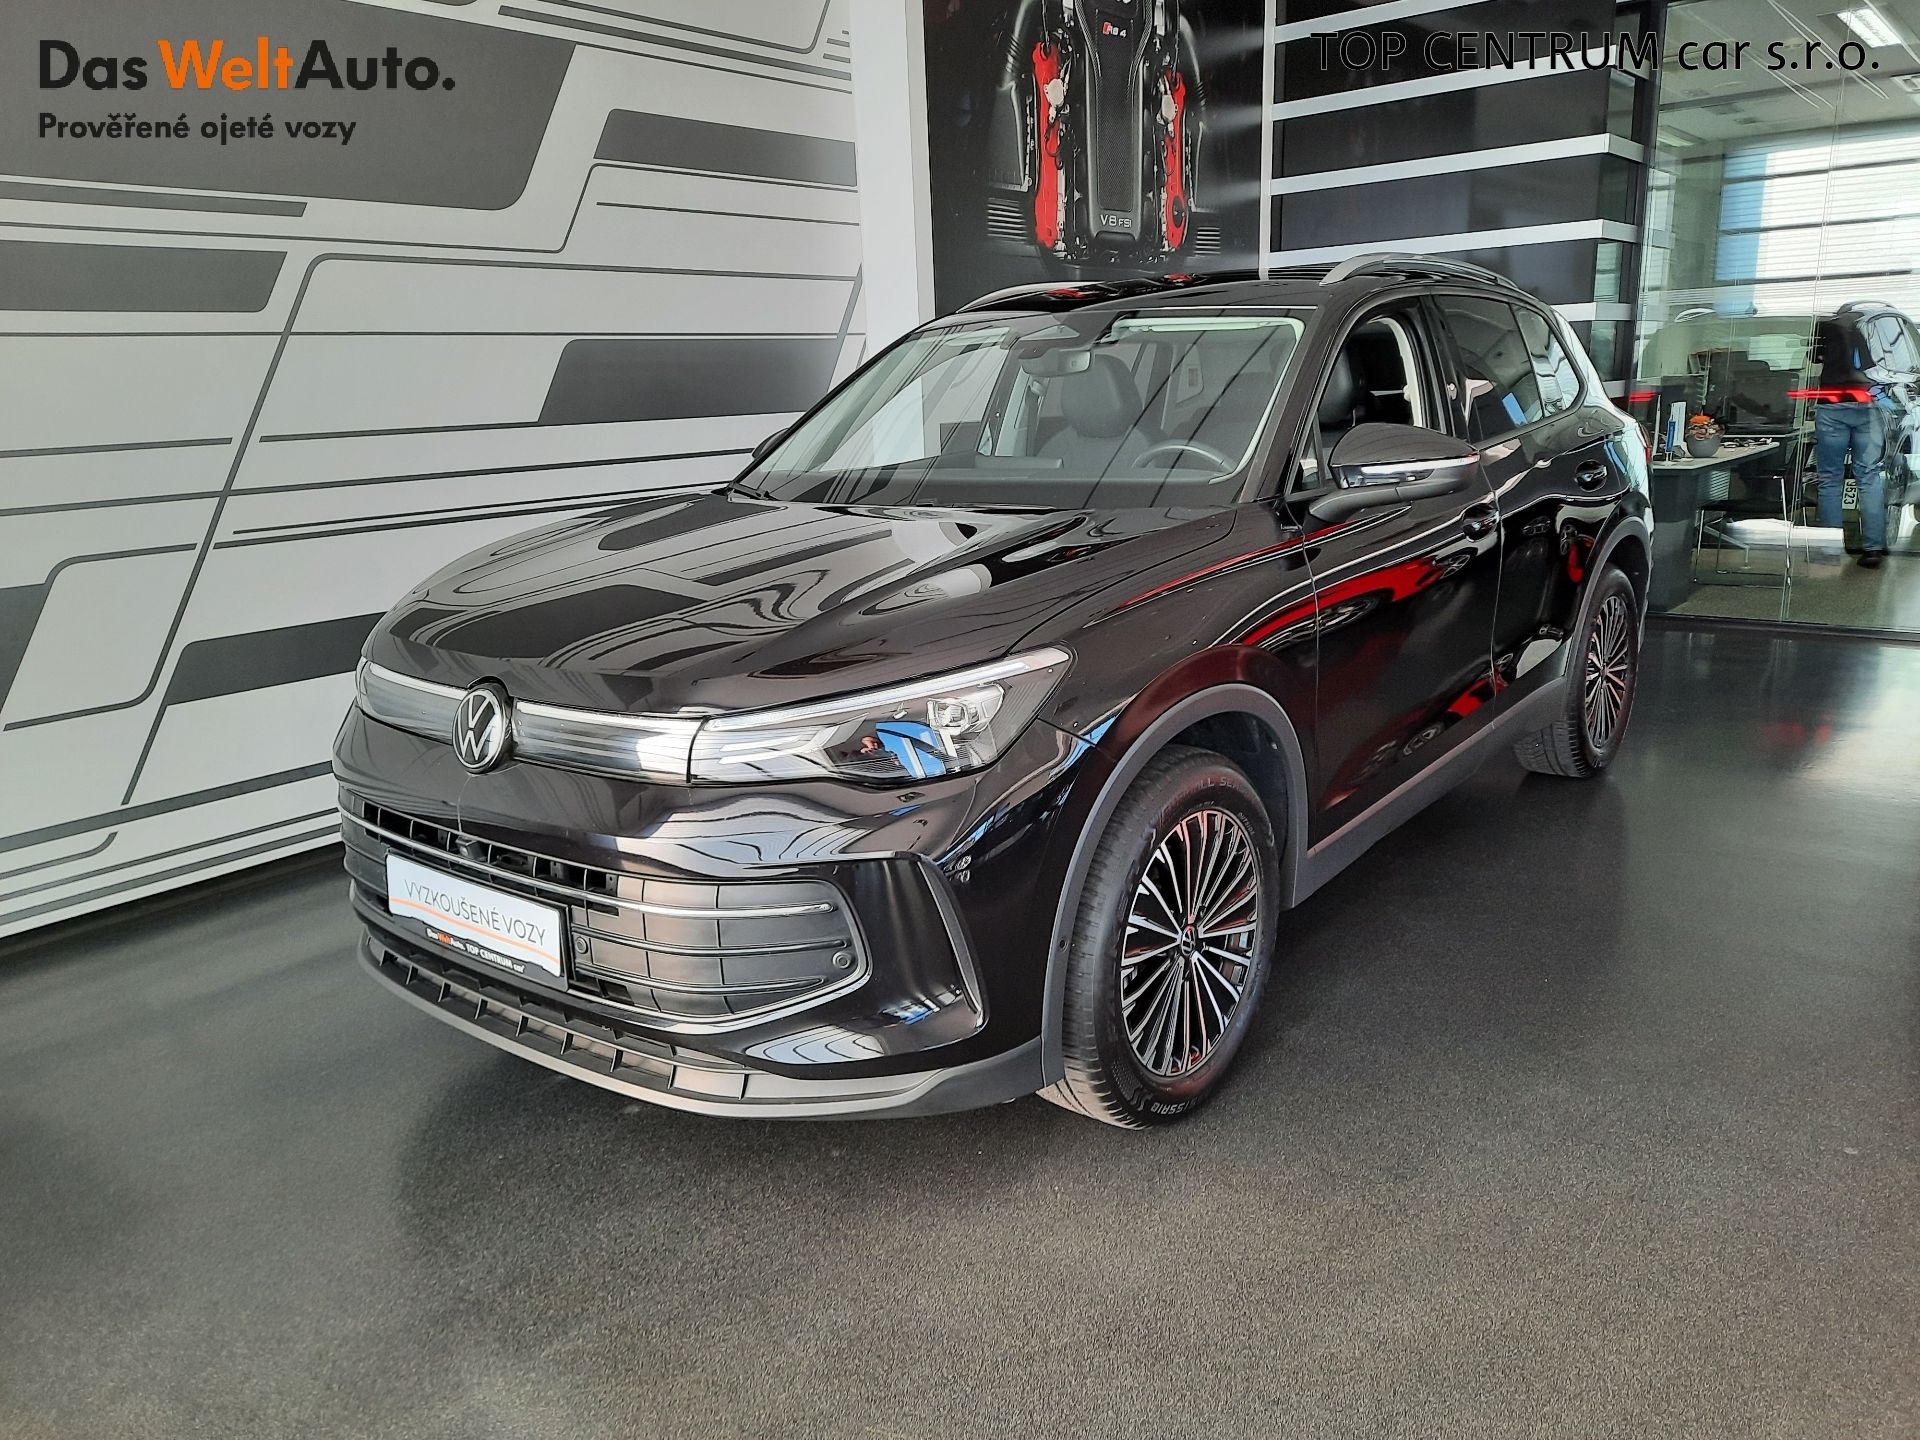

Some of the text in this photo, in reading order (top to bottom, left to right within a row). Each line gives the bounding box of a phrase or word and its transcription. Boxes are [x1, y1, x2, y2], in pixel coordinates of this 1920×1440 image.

[1100, 214, 1117, 226] V8
[404, 880, 546, 946] VYZKOUŠENÉ VOZY
